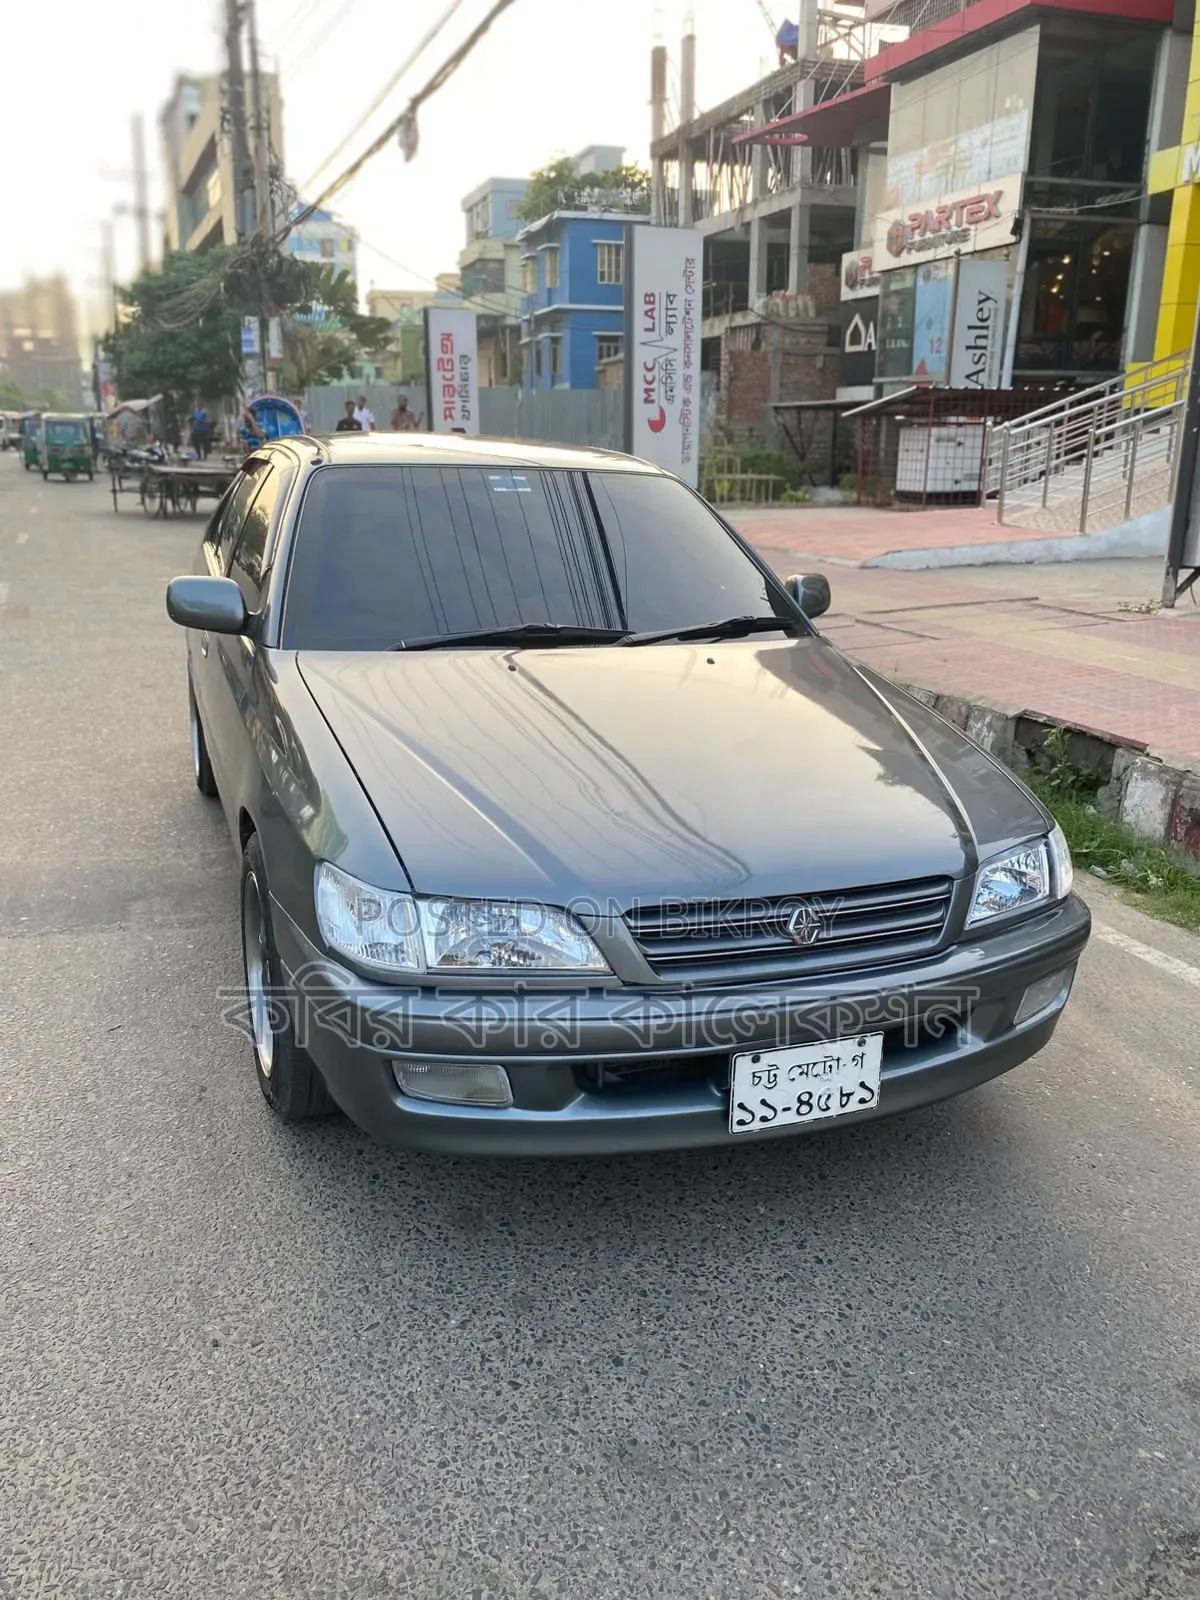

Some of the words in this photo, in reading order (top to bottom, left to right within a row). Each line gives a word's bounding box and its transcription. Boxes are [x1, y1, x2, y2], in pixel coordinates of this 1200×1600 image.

[906, 190, 1004, 239] PARTEX
[643, 292, 656, 332] LAB
[665, 291, 678, 337] ল্যাব
[964, 288, 998, 389] Ashley
[643, 361, 656, 404] MCC
[661, 357, 677, 404] এমসিসি
